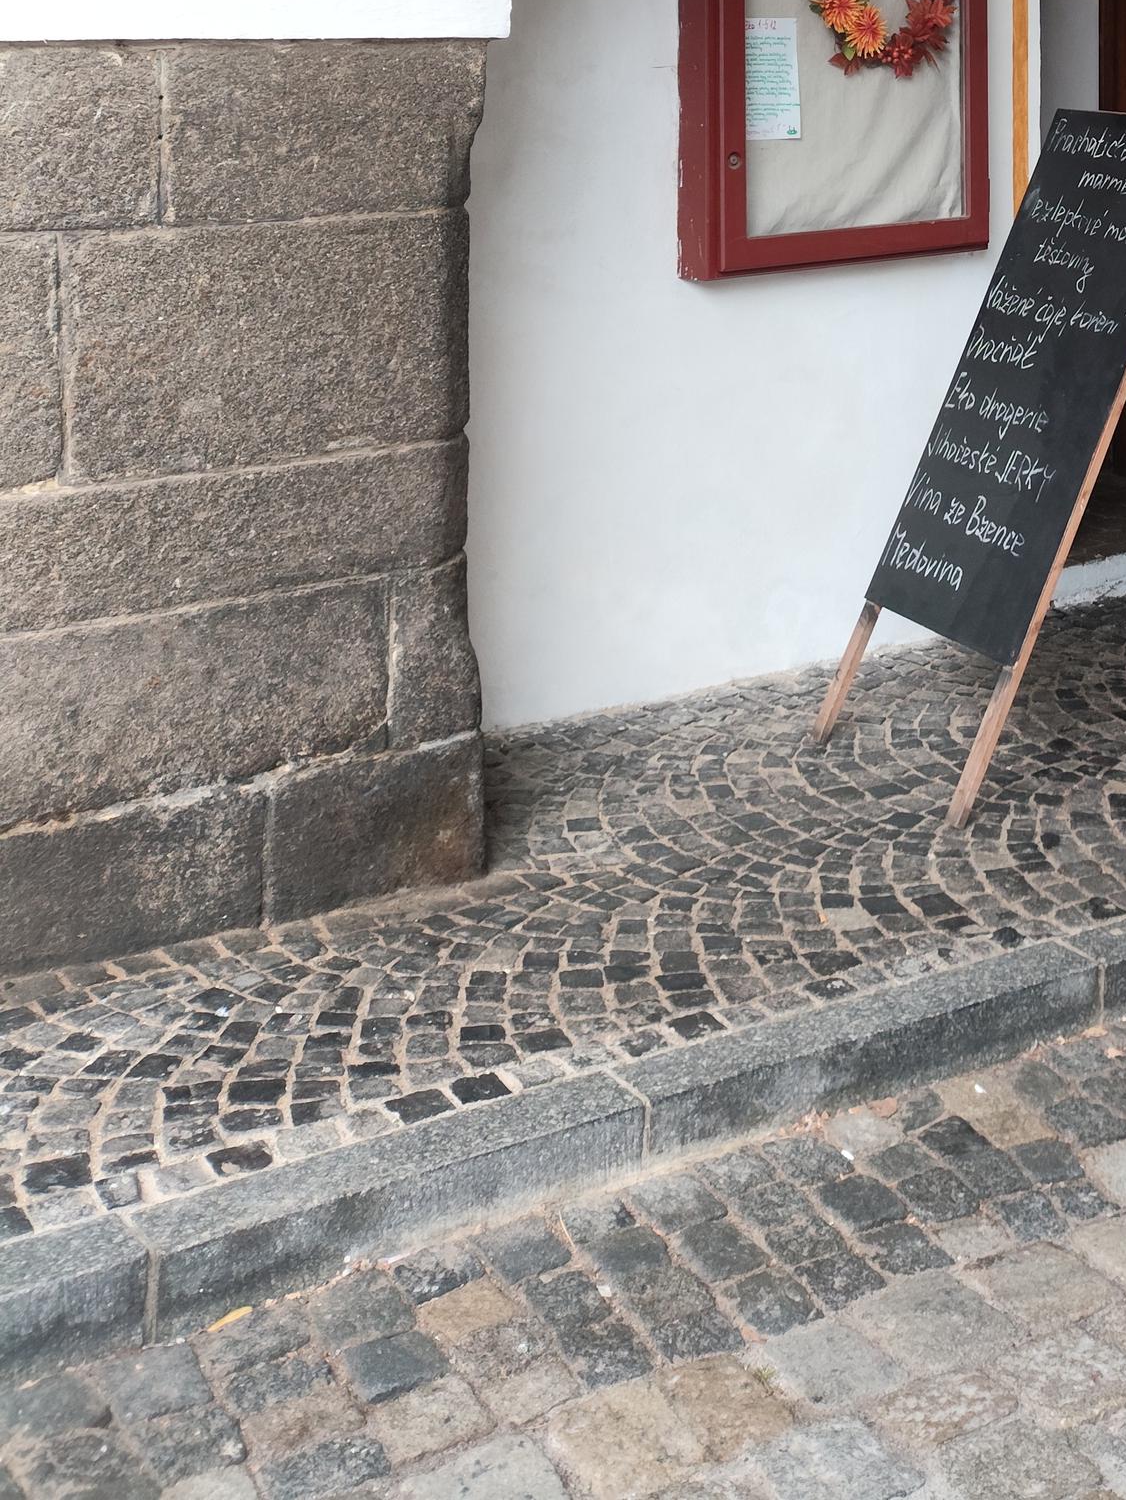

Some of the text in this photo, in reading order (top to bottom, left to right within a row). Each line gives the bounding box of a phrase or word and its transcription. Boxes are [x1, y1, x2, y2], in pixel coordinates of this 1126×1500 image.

[944, 371, 1050, 440] Eko drogerie
[995, 450, 1057, 503] JERKY
[881, 521, 964, 592] Medovina
[943, 497, 966, 525] ze
[965, 494, 1026, 557] Bzence
